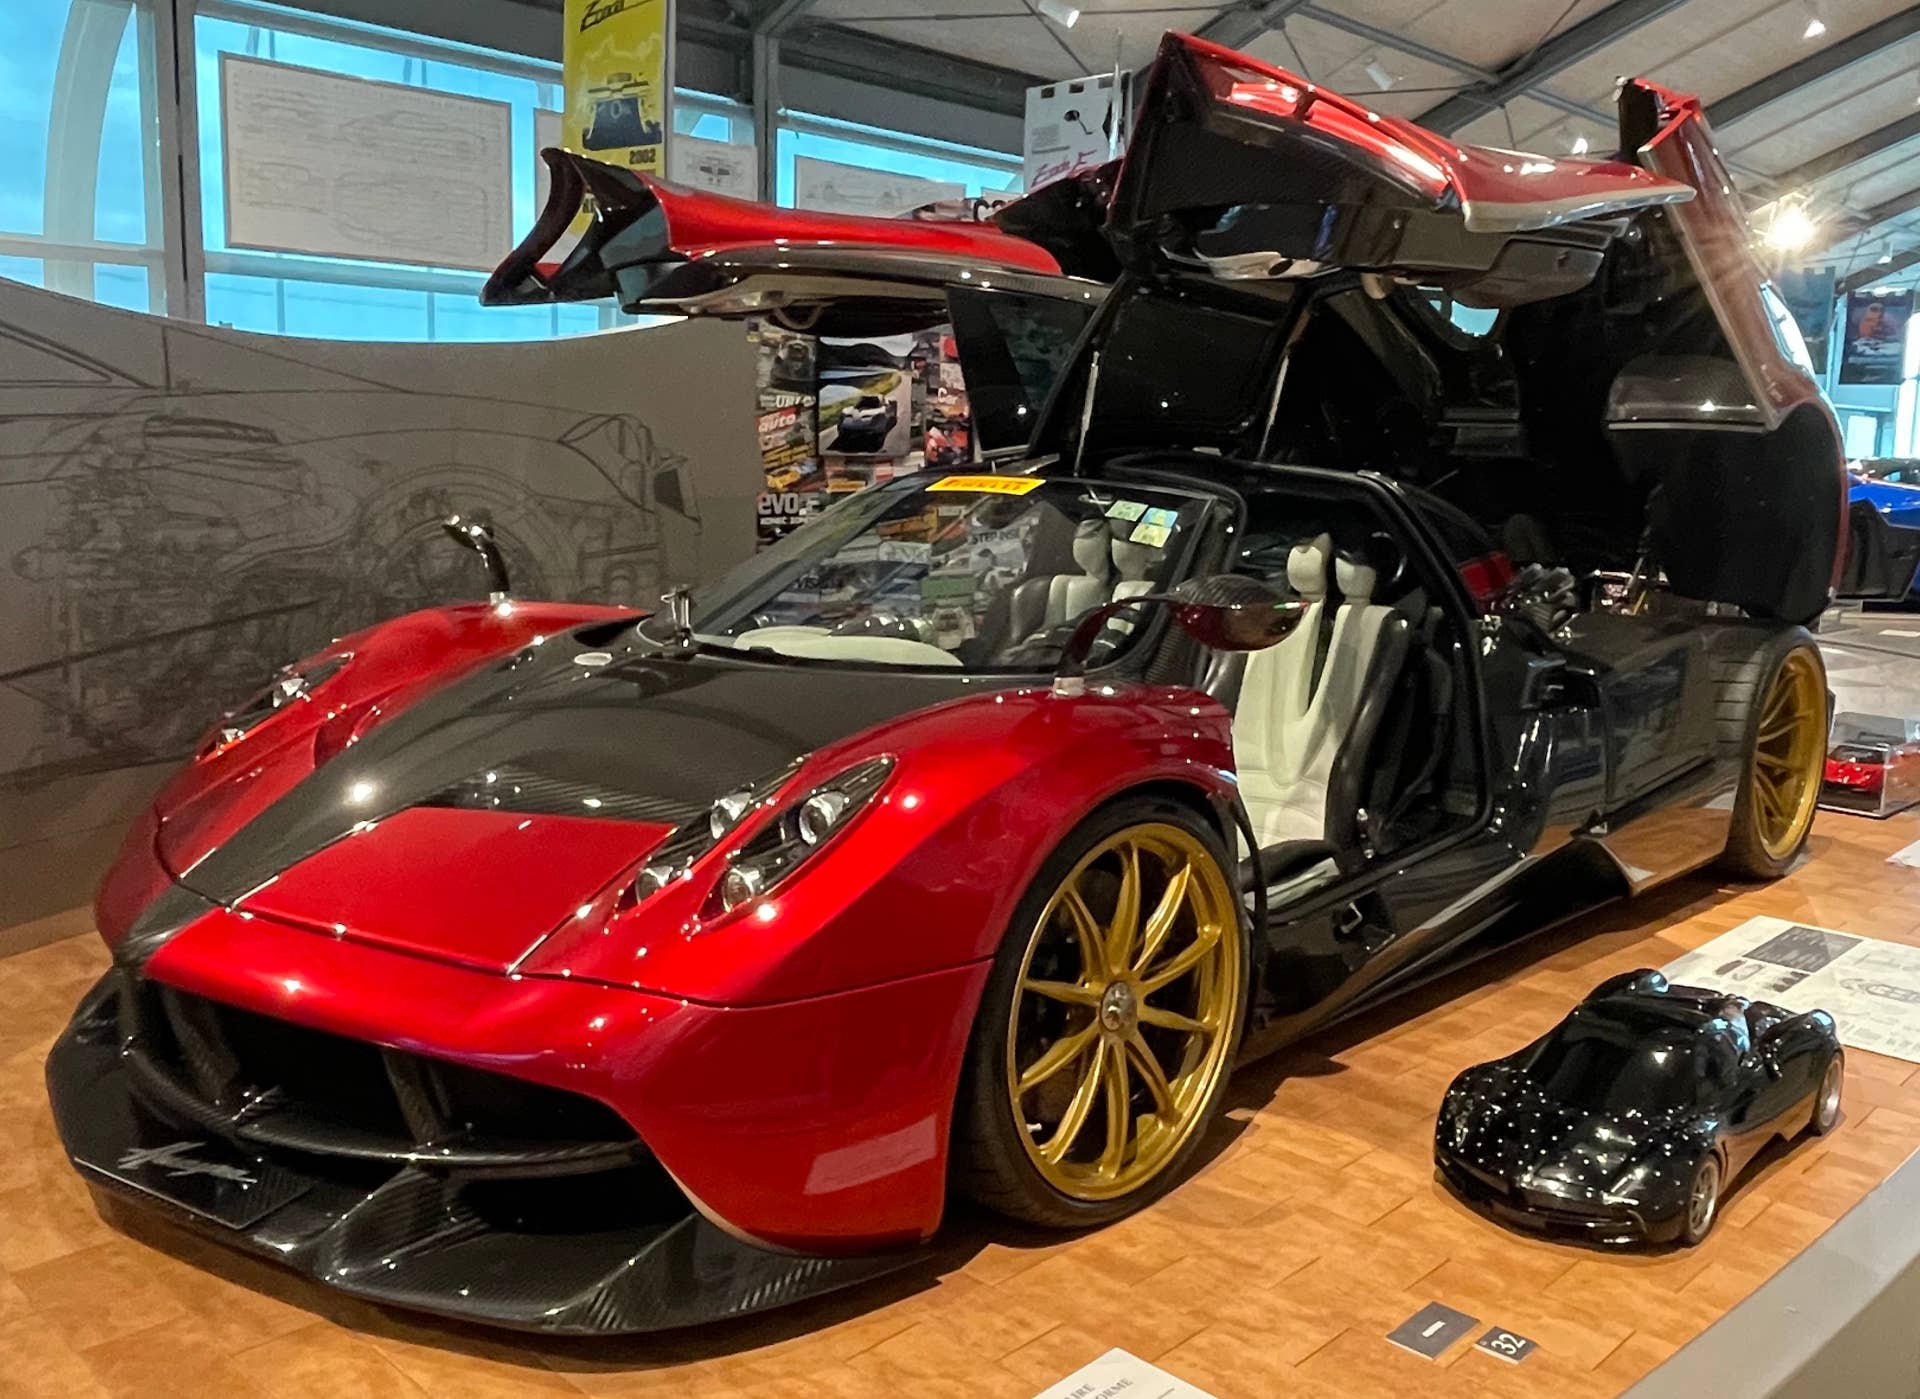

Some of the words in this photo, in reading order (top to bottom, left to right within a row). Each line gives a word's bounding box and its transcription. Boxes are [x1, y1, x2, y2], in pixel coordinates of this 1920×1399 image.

[629, 148, 656, 164] 2002
[758, 492, 799, 515] evo
[1491, 1333, 1527, 1355] 32
